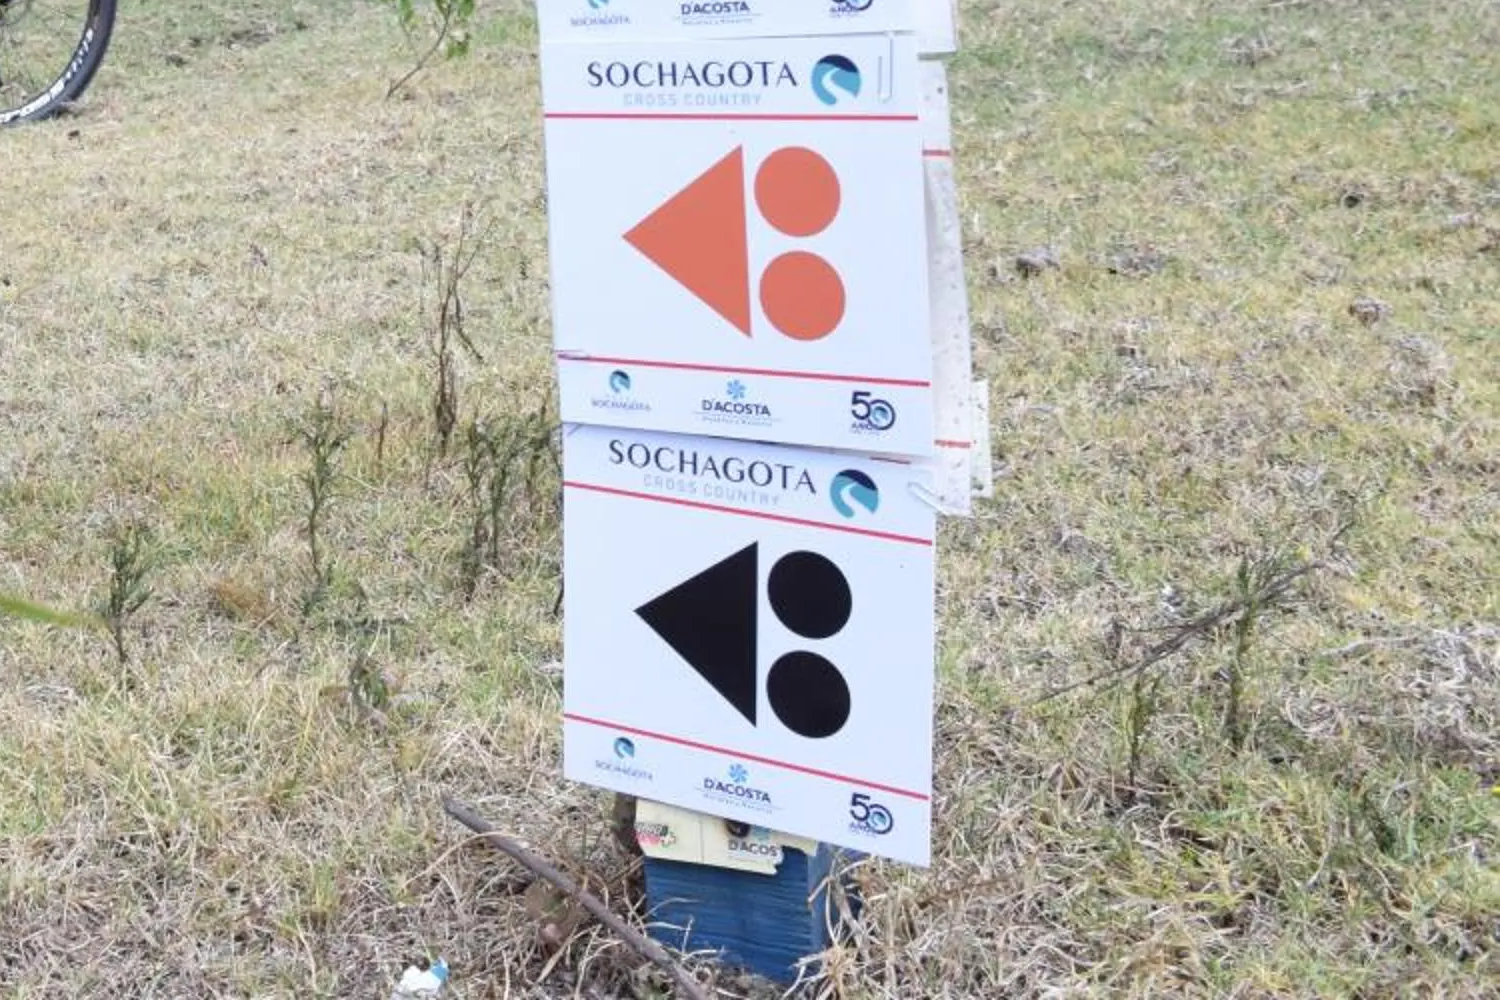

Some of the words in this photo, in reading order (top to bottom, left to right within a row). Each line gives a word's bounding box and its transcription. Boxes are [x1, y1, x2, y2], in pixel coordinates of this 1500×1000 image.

[681, 1, 751, 16] D'ACOSTA
[587, 60, 799, 88] SOCHAGOTA
[623, 92, 678, 107] CROSS
[684, 92, 762, 107] COUNTRY
[702, 399, 772, 417] D'ACOSTA
[608, 439, 817, 495] SOCHAGOTA
[643, 474, 697, 496] CROSS
[703, 482, 781, 506] COUNTRY
[703, 776, 773, 804] D'ACOSTA
